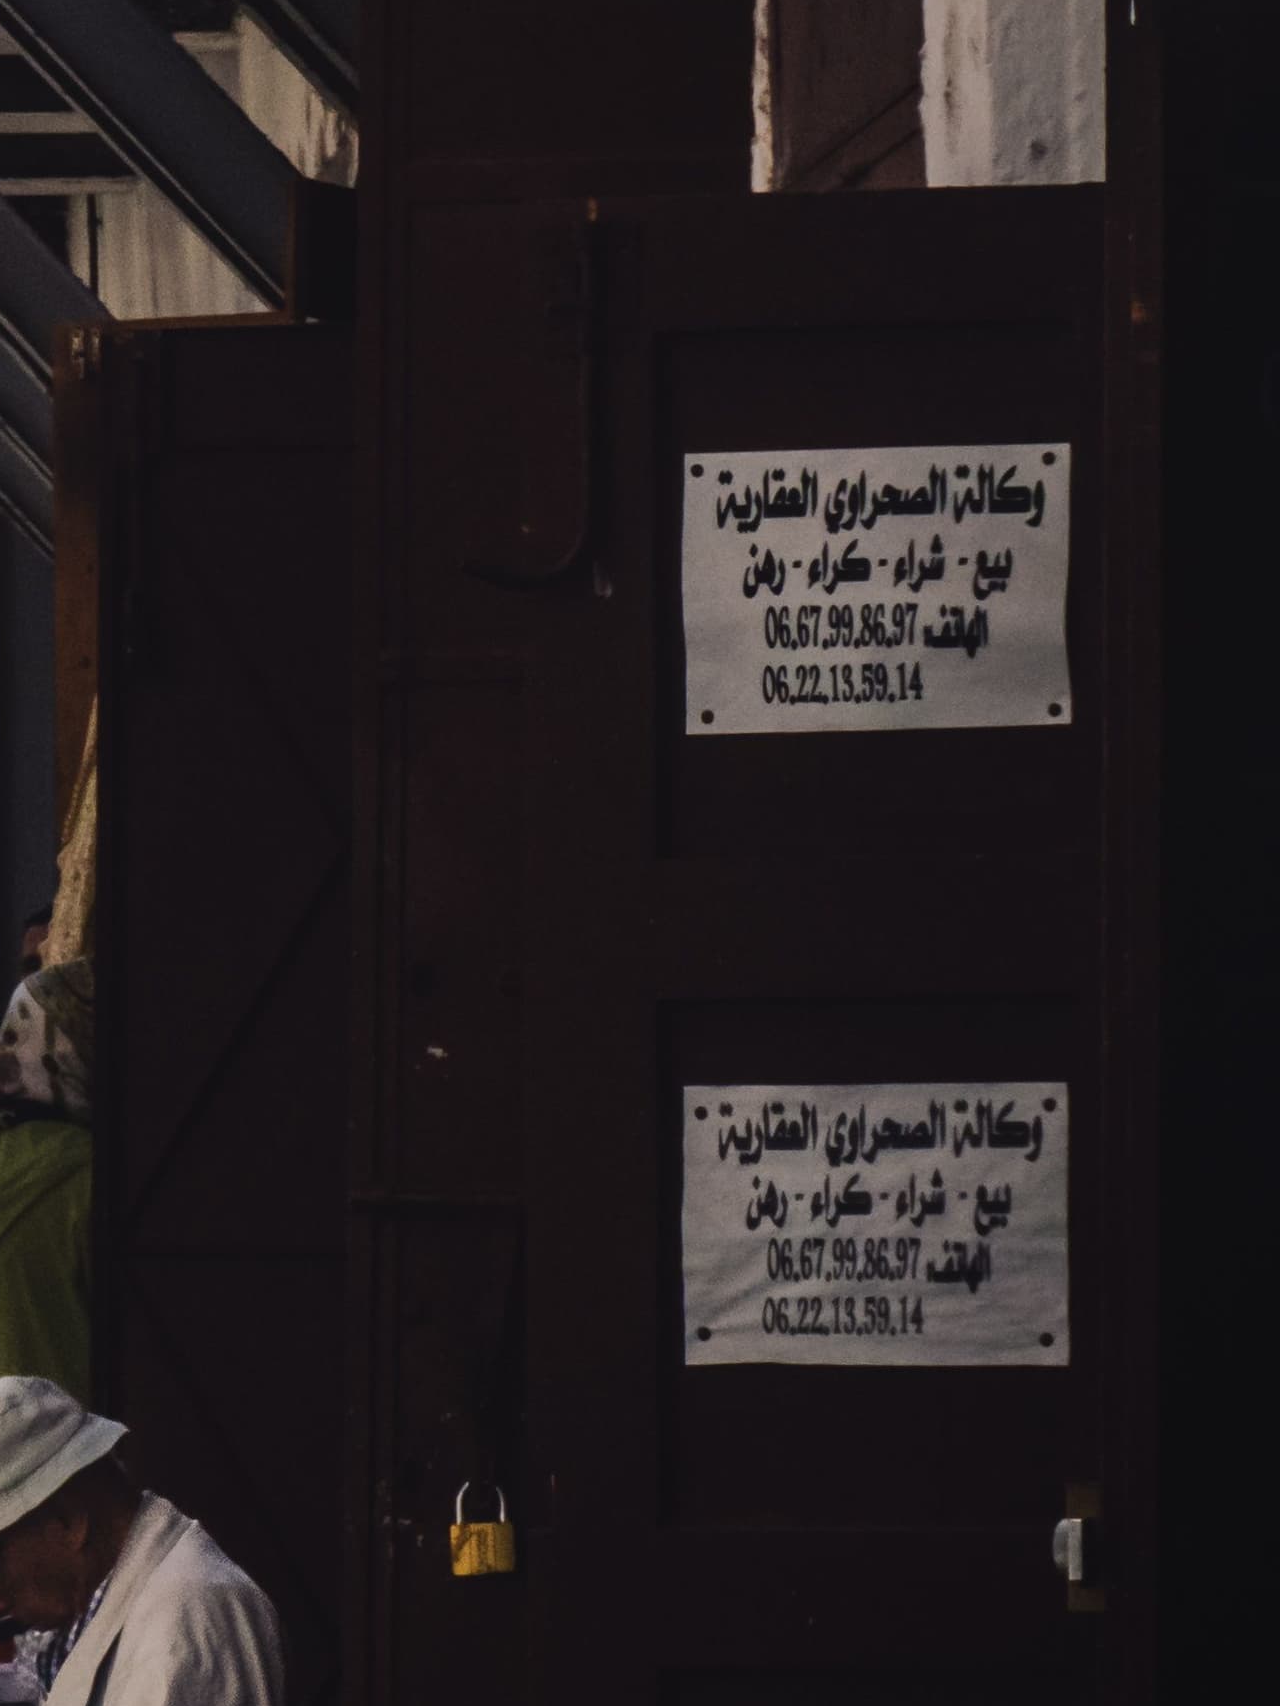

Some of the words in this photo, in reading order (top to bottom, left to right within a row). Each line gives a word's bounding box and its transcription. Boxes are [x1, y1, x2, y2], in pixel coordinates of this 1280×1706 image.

[716, 468, 818, 533] العقارية
[824, 464, 948, 535] الصحراوي
[953, 463, 1045, 528] وكالة
[743, 544, 786, 599] رهن
[808, 539, 872, 595] كراء
[894, 534, 946, 593] شراء
[972, 548, 1013, 601] بيع
[764, 602, 918, 651] 06.67.99.86.97
[762, 661, 924, 705] 06.22.13.59.14
[718, 1101, 818, 1166] العقارية
[824, 1099, 946, 1168] الصحراوي
[953, 1099, 1044, 1163] وكالة
[745, 1175, 788, 1231] رهن
[810, 1173, 873, 1229] كراء
[896, 1169, 947, 1228] شراء
[974, 1184, 1012, 1235] بيع
[768, 1237, 921, 1283] 06.67.99.86.97
[762, 1295, 924, 1337] 06.22.13.59.14
